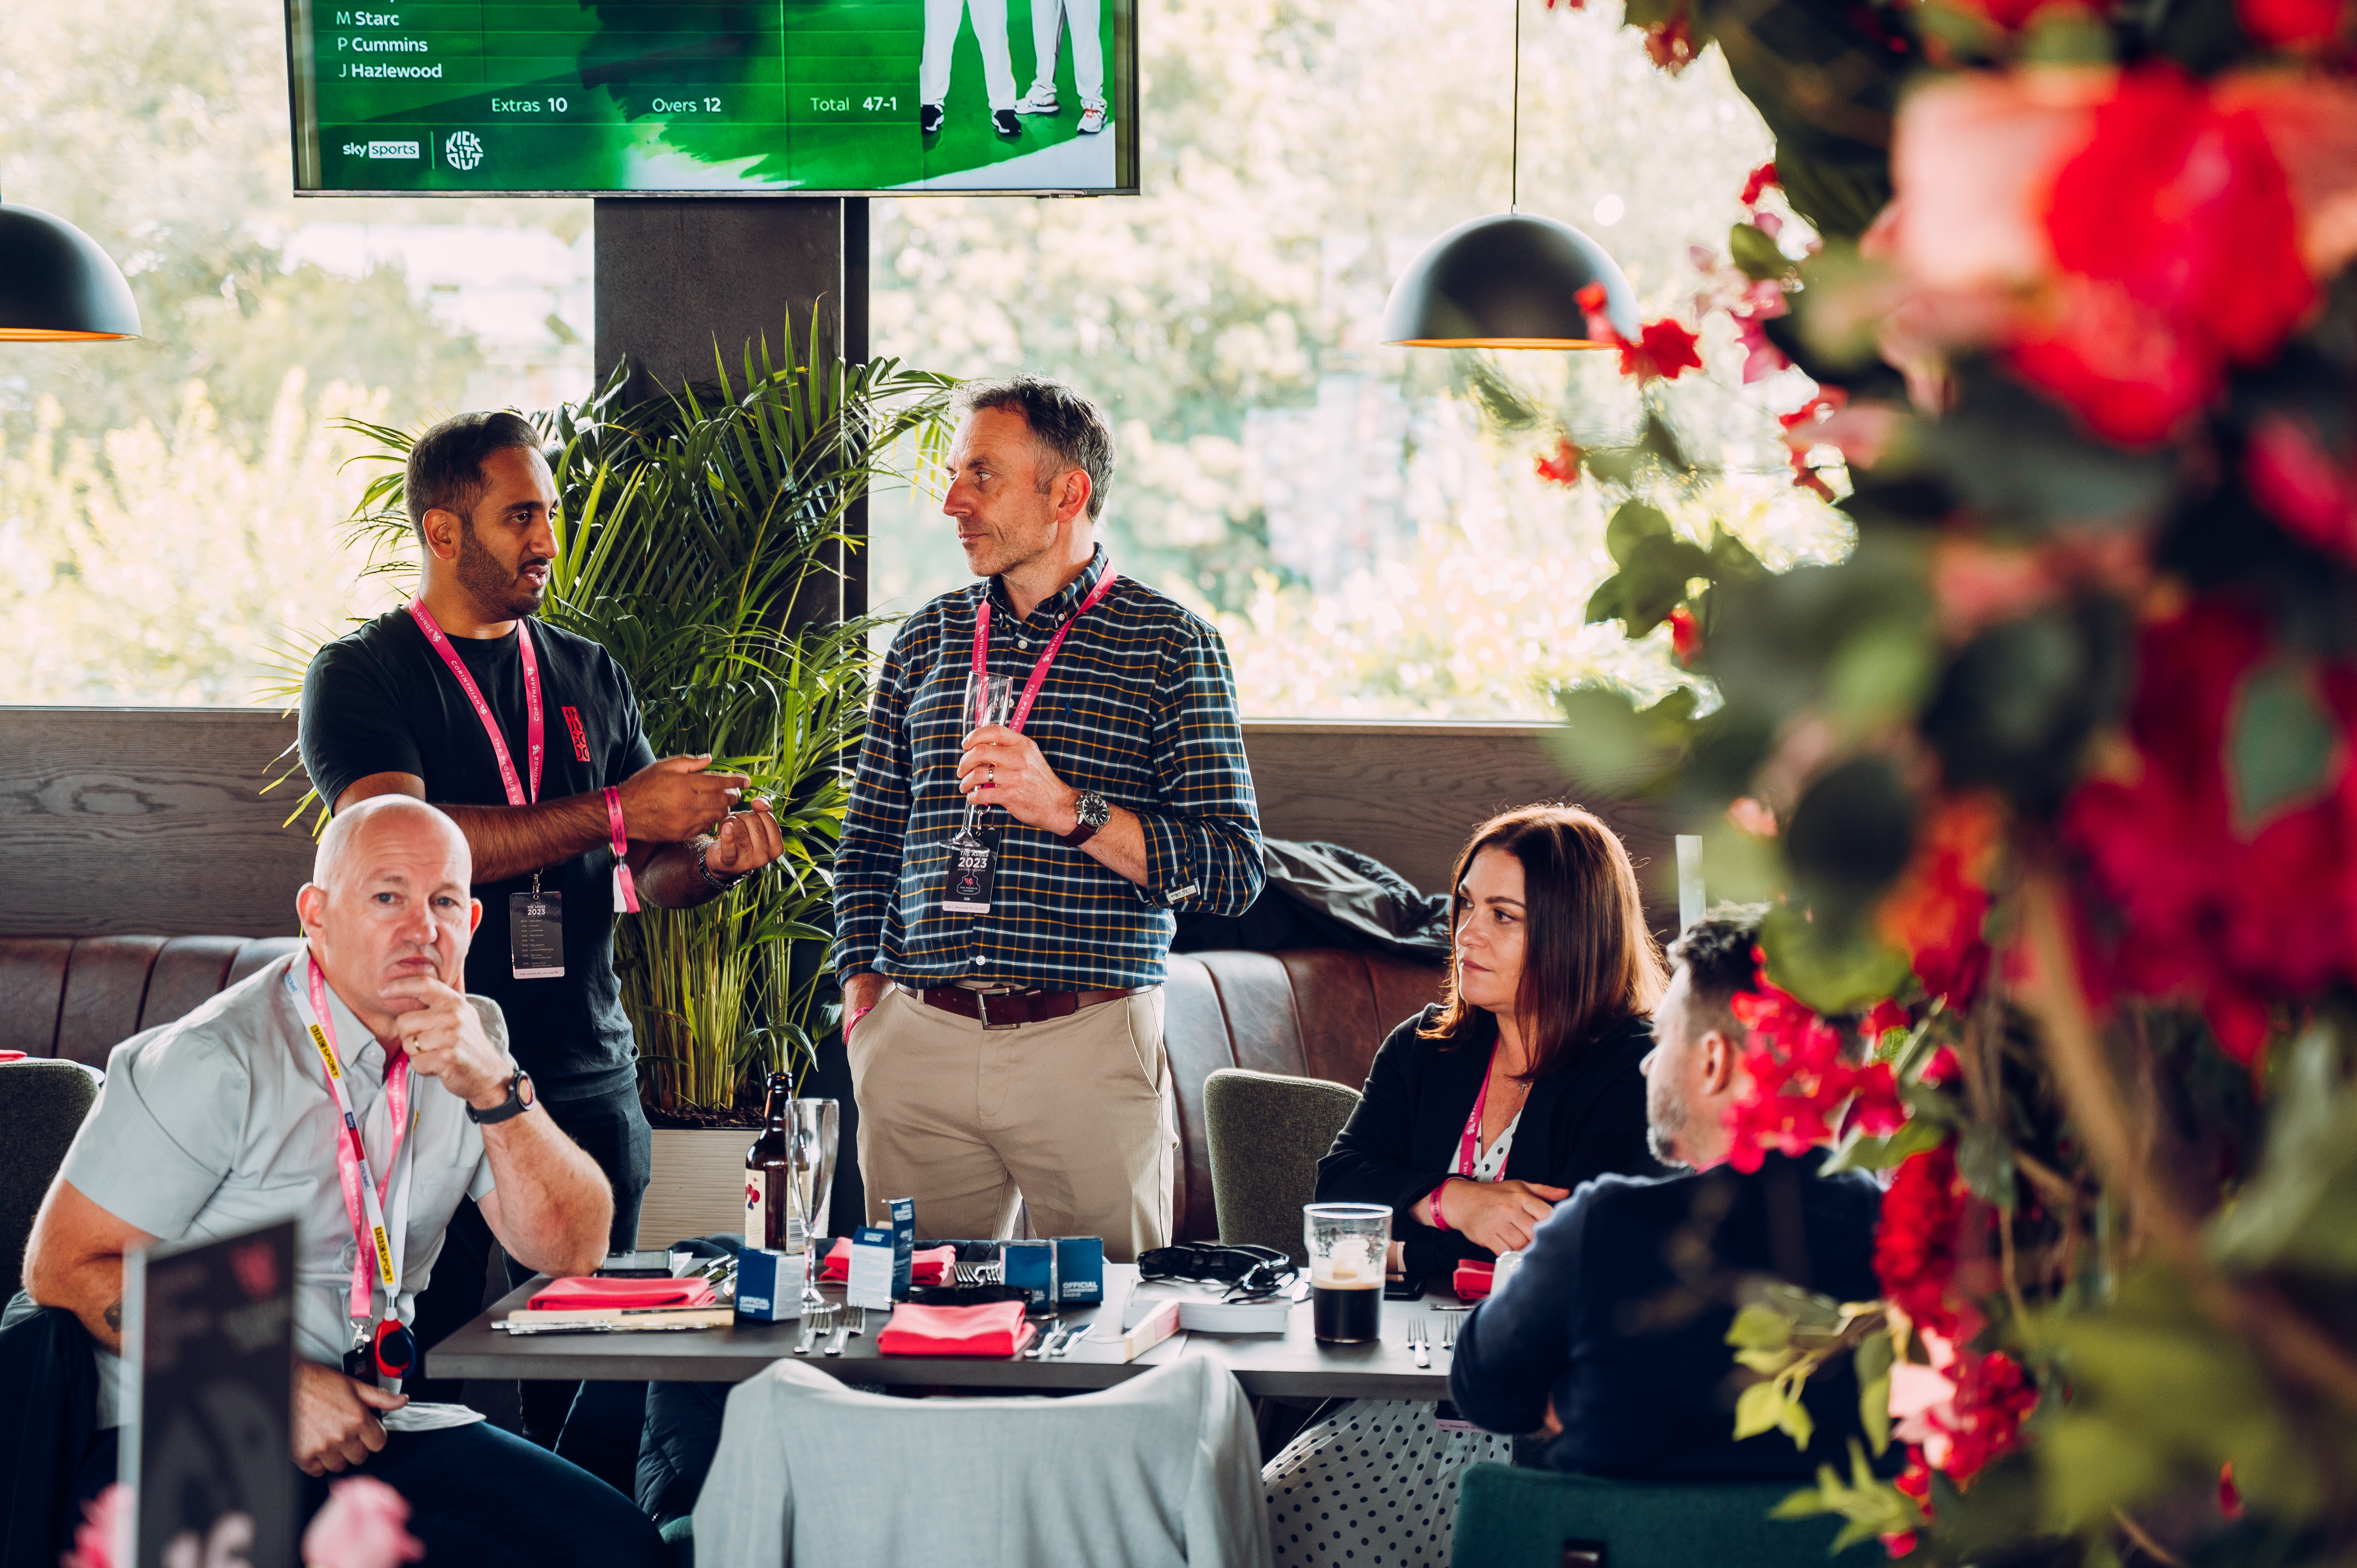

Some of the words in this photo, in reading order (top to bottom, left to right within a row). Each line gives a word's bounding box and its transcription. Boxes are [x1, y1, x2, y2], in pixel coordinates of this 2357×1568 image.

[336, 11, 351, 25] M
[355, 11, 399, 26] Starc
[338, 37, 348, 51] P
[352, 37, 428, 52] Cummins
[339, 64, 346, 78] J
[351, 63, 442, 78] Hazlewood
[492, 97, 540, 112] Extras
[548, 97, 567, 112] 10
[652, 97, 697, 112] Overs
[704, 97, 721, 112] 12
[810, 97, 849, 112] Total
[862, 96, 897, 111] 47-1
[343, 142, 367, 157] sky
[372, 144, 416, 156] sports
[446, 131, 483, 153] KICK
[446, 153, 483, 170] OUT
[1099, 570, 1113, 590] LOUNGE
[415, 609, 434, 633] LOUNGE
[451, 661, 480, 705] CORINTHIAN
[1024, 684, 1035, 699] THE
[531, 677, 539, 721] CORINTHIAN
[1011, 701, 1027, 732] PEGASU
[501, 756, 516, 792] PEGASUS
[958, 857, 987, 868] 2023
[323, 1047, 339, 1076] SPORT
[381, 1252, 393, 1282] SPORT
